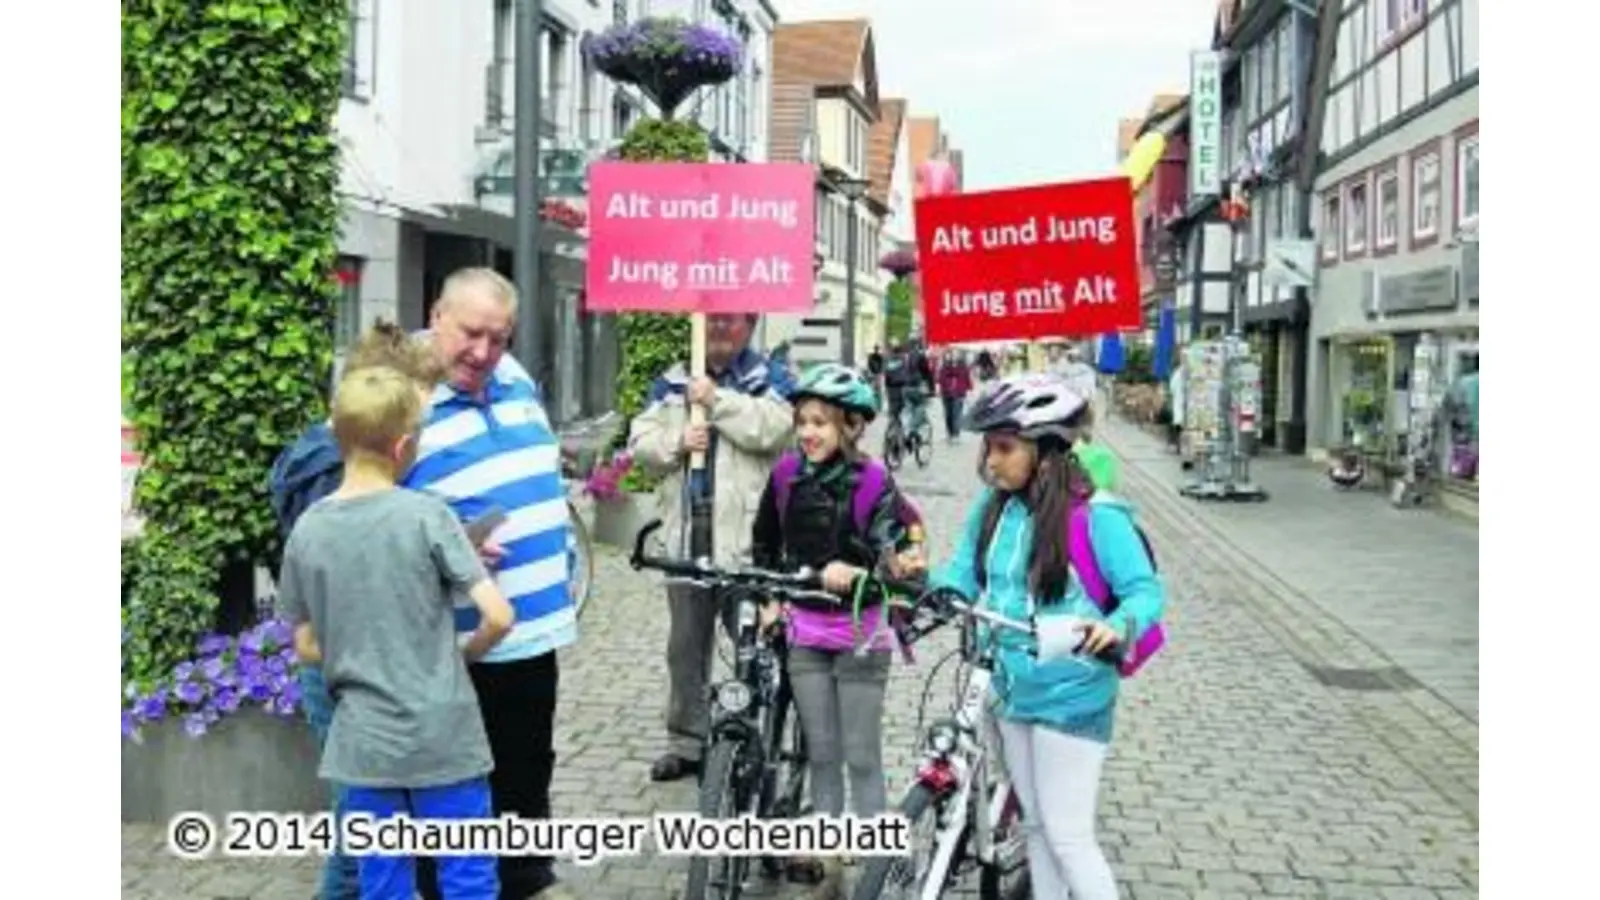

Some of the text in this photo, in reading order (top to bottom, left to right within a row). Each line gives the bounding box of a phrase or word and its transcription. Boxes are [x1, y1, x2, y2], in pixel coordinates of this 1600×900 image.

[1199, 76, 1216, 186] HOTEL
[606, 193, 651, 218] Alt
[660, 193, 719, 219] und
[724, 193, 798, 228] Jung
[932, 215, 1116, 255] Alt und Jung
[608, 256, 792, 289] Jung mit Alt
[940, 276, 1116, 316] Jung mit Alt
